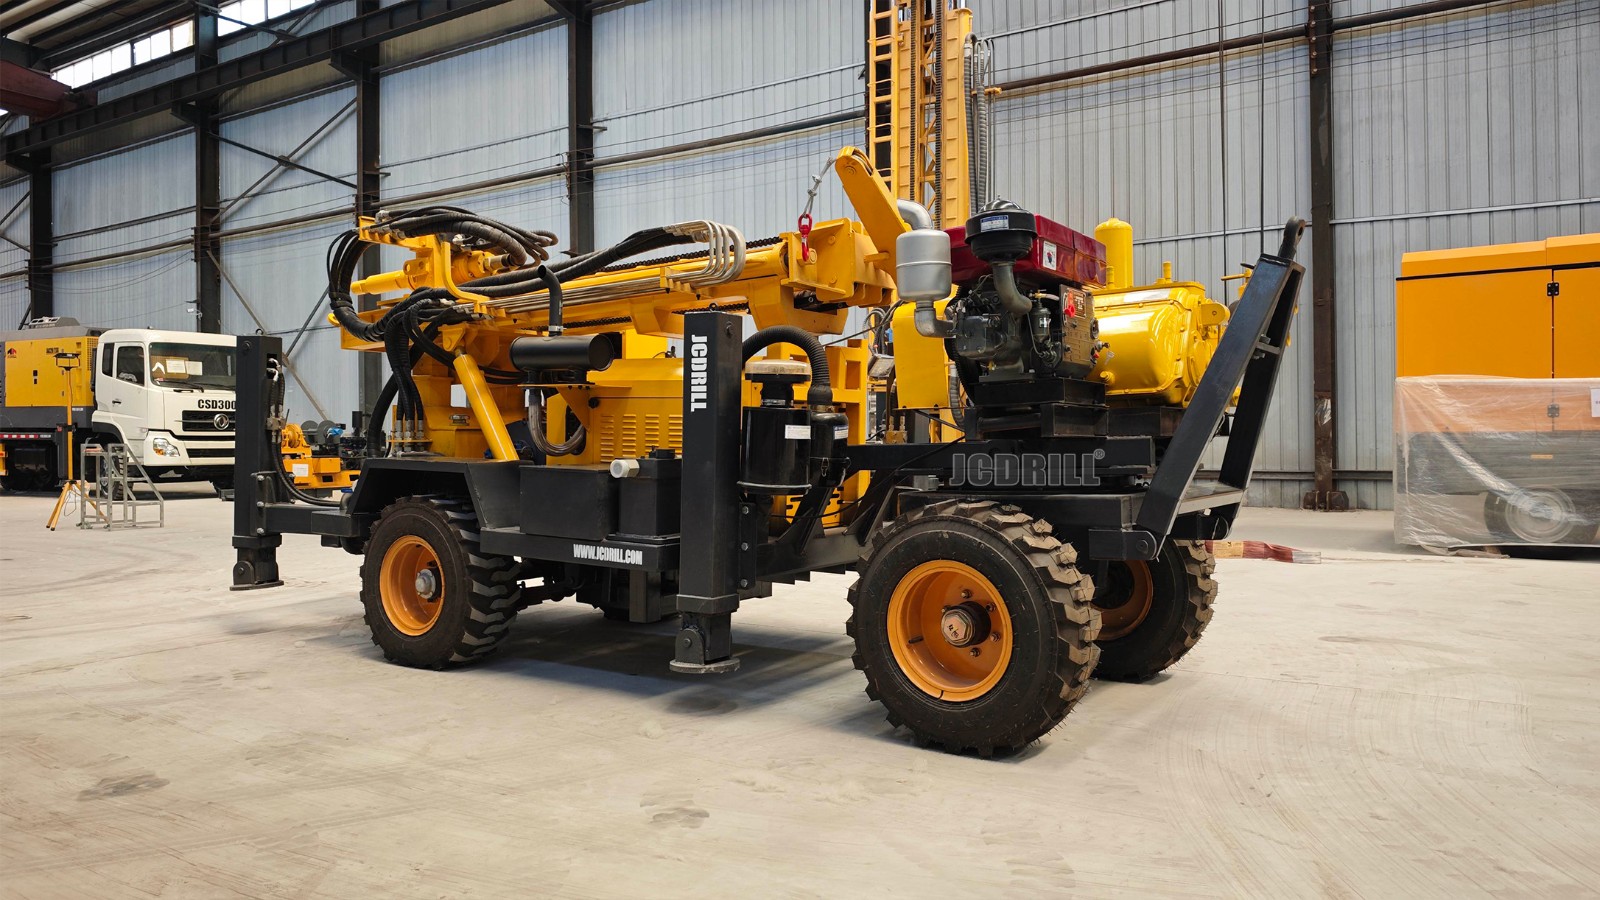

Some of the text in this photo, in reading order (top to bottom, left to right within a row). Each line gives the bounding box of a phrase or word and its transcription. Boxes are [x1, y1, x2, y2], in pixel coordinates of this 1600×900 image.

[691, 334, 708, 412] JCDRILL
[197, 399, 237, 410] CSD300
[573, 543, 643, 566] WWW.JCDRILL.COM
